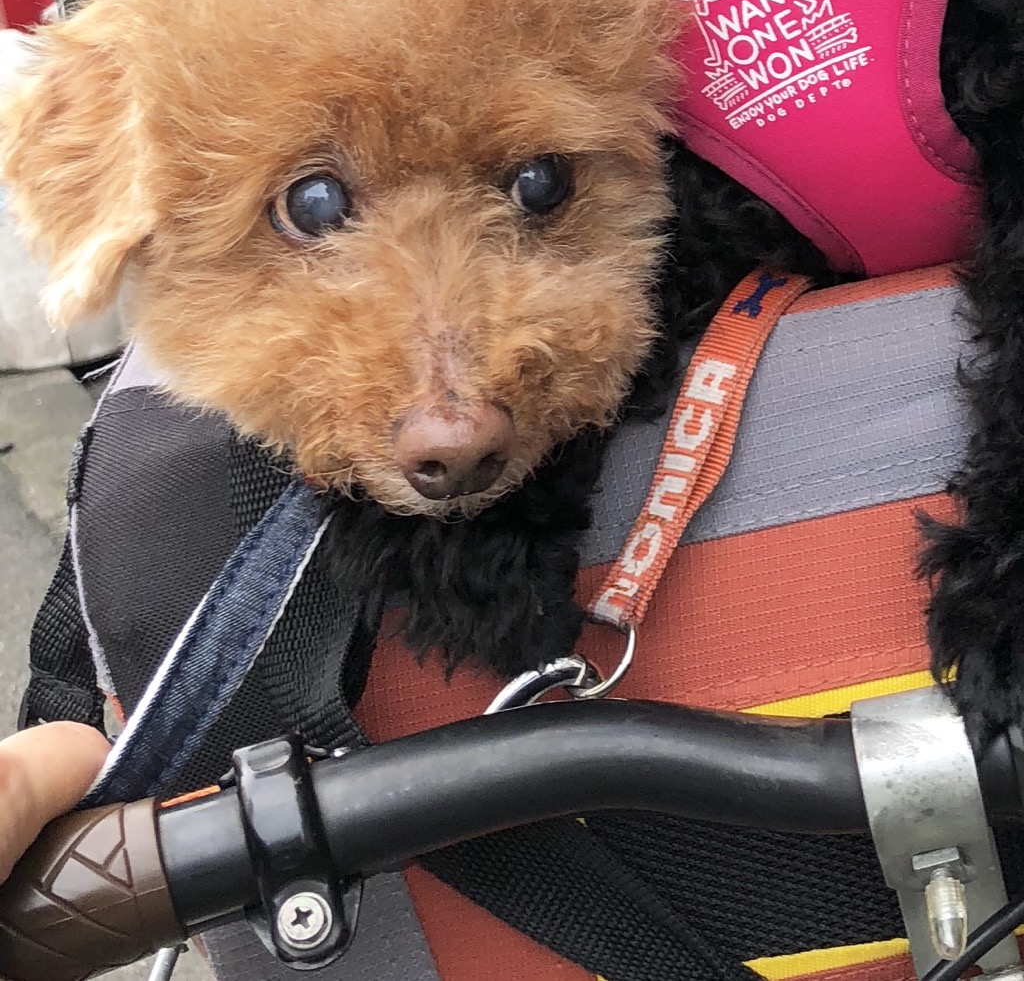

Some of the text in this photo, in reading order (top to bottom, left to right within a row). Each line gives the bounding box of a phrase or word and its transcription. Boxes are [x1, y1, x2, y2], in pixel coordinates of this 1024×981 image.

[727, 9, 803, 66] ONE
[738, 38, 816, 91] WON
[729, 102, 766, 130] ENJOY
[763, 85, 799, 110] YOUR
[797, 69, 830, 90] DOG
[756, 108, 788, 128] DOG
